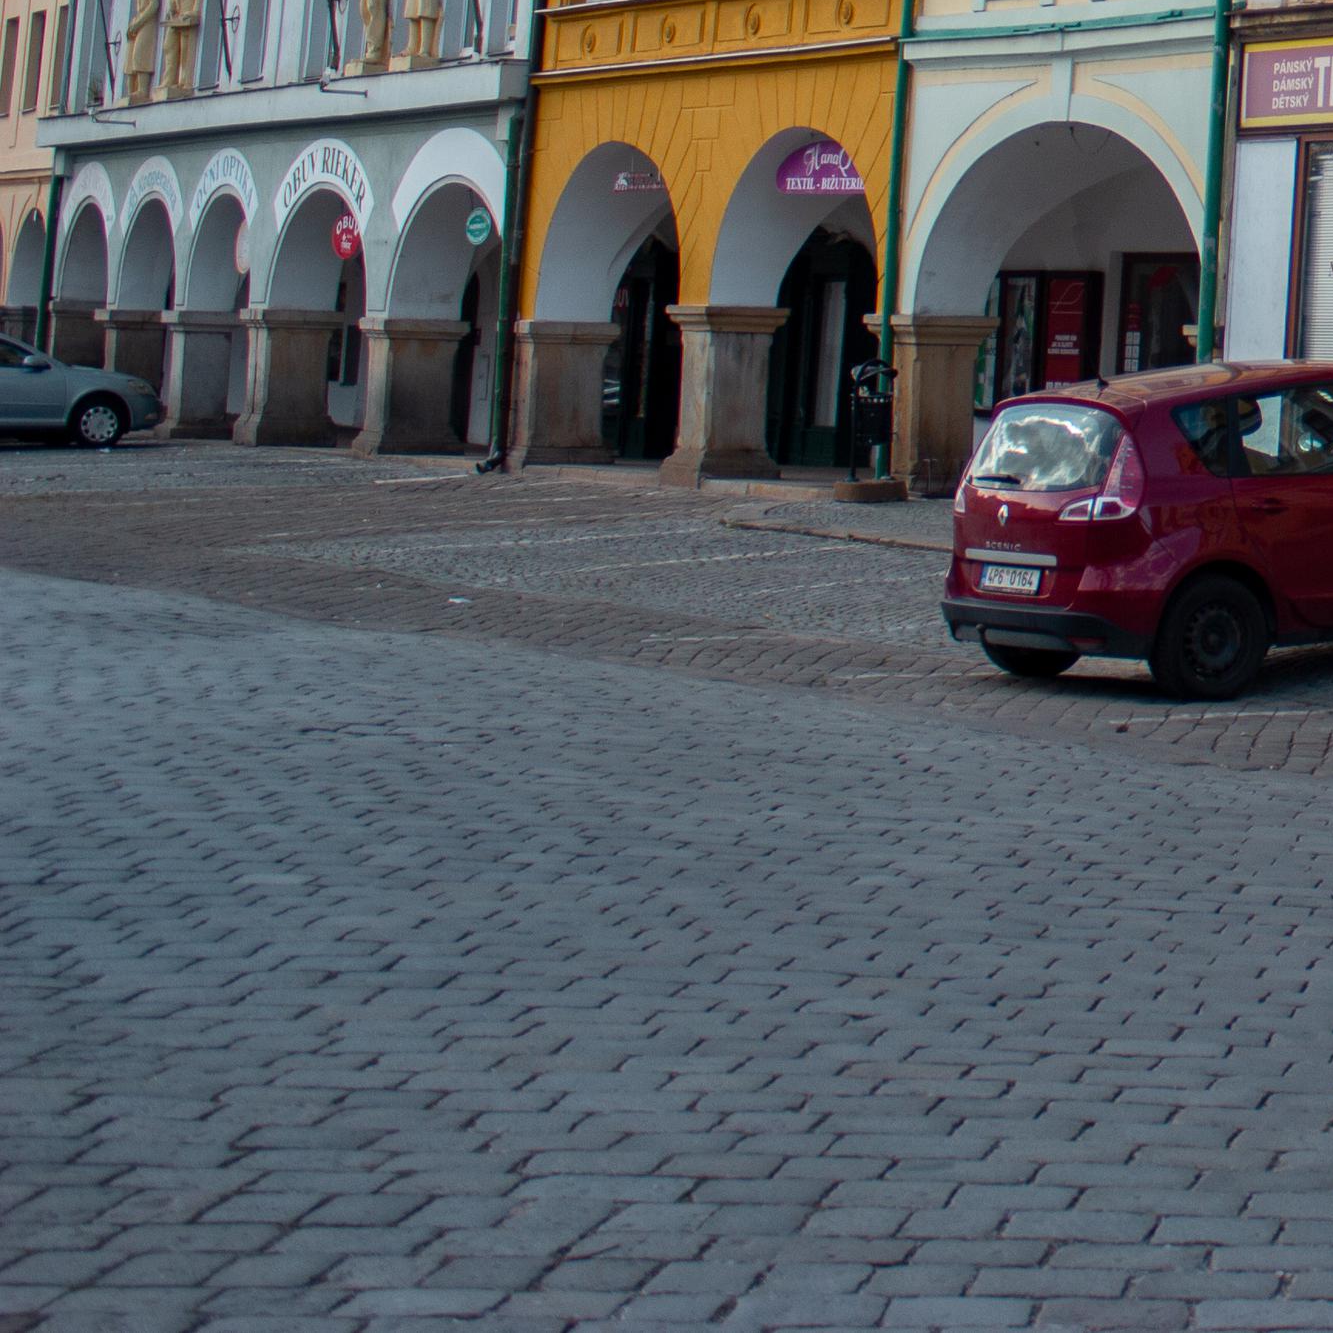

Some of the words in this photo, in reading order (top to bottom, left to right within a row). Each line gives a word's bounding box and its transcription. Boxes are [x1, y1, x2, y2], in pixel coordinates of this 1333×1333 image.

[1273, 58, 1313, 74] PÁNSKÝ
[1273, 76, 1313, 92] DÁMSKÝ
[1272, 94, 1309, 109] DĚTSKÝ
[283, 145, 320, 209] OBUV
[322, 147, 366, 213] RIEKER
[786, 177, 816, 190] TEXTIL
[986, 540, 1021, 552] SCENIC
[1009, 570, 1034, 587] 0164
